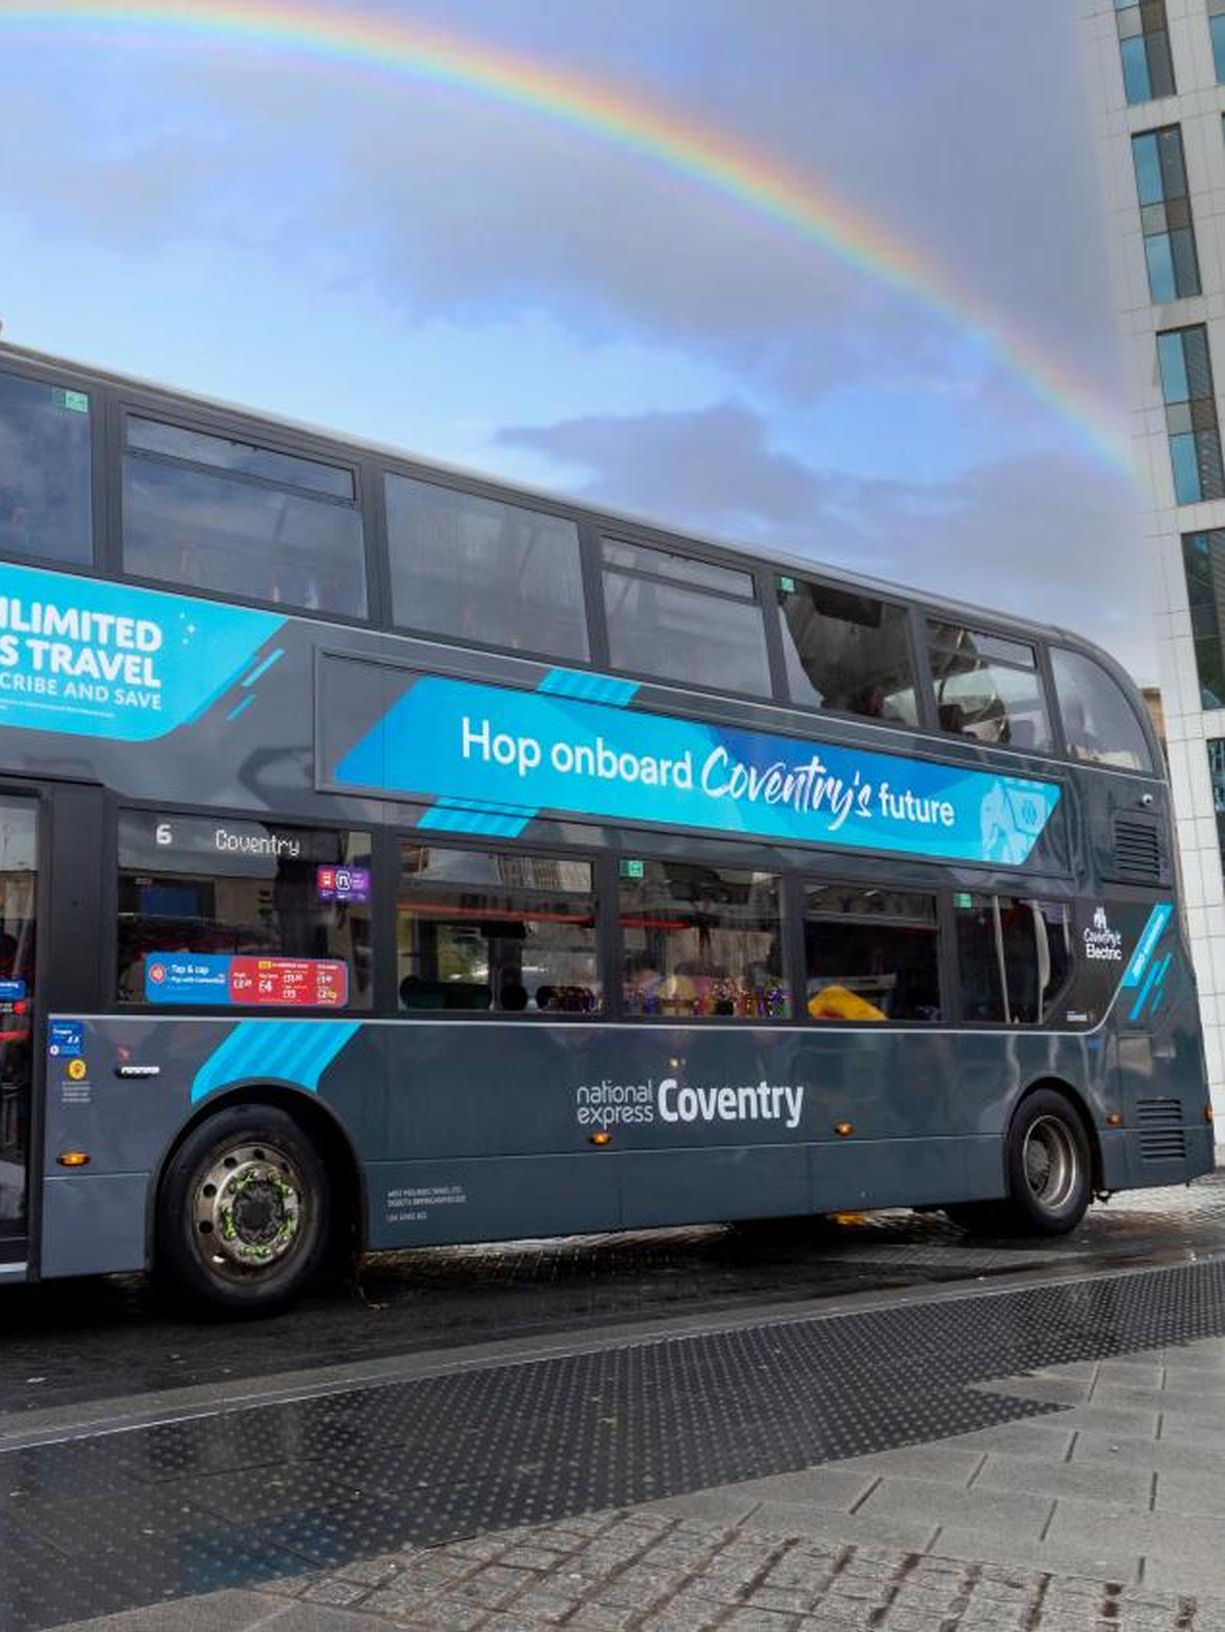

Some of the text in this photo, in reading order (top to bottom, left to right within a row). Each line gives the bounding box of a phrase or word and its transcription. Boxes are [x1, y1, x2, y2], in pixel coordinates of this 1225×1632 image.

[25, 638, 163, 689] TRAVEL
[63, 681, 109, 703] AND
[114, 688, 163, 711] SAVE
[460, 716, 955, 831] Hop onboard Coventry's future
[156, 824, 300, 857] 6 Coventry
[1085, 943, 1123, 960] Electric
[576, 1079, 654, 1105] national
[657, 1078, 804, 1128] Coventry
[576, 1105, 654, 1130] express
